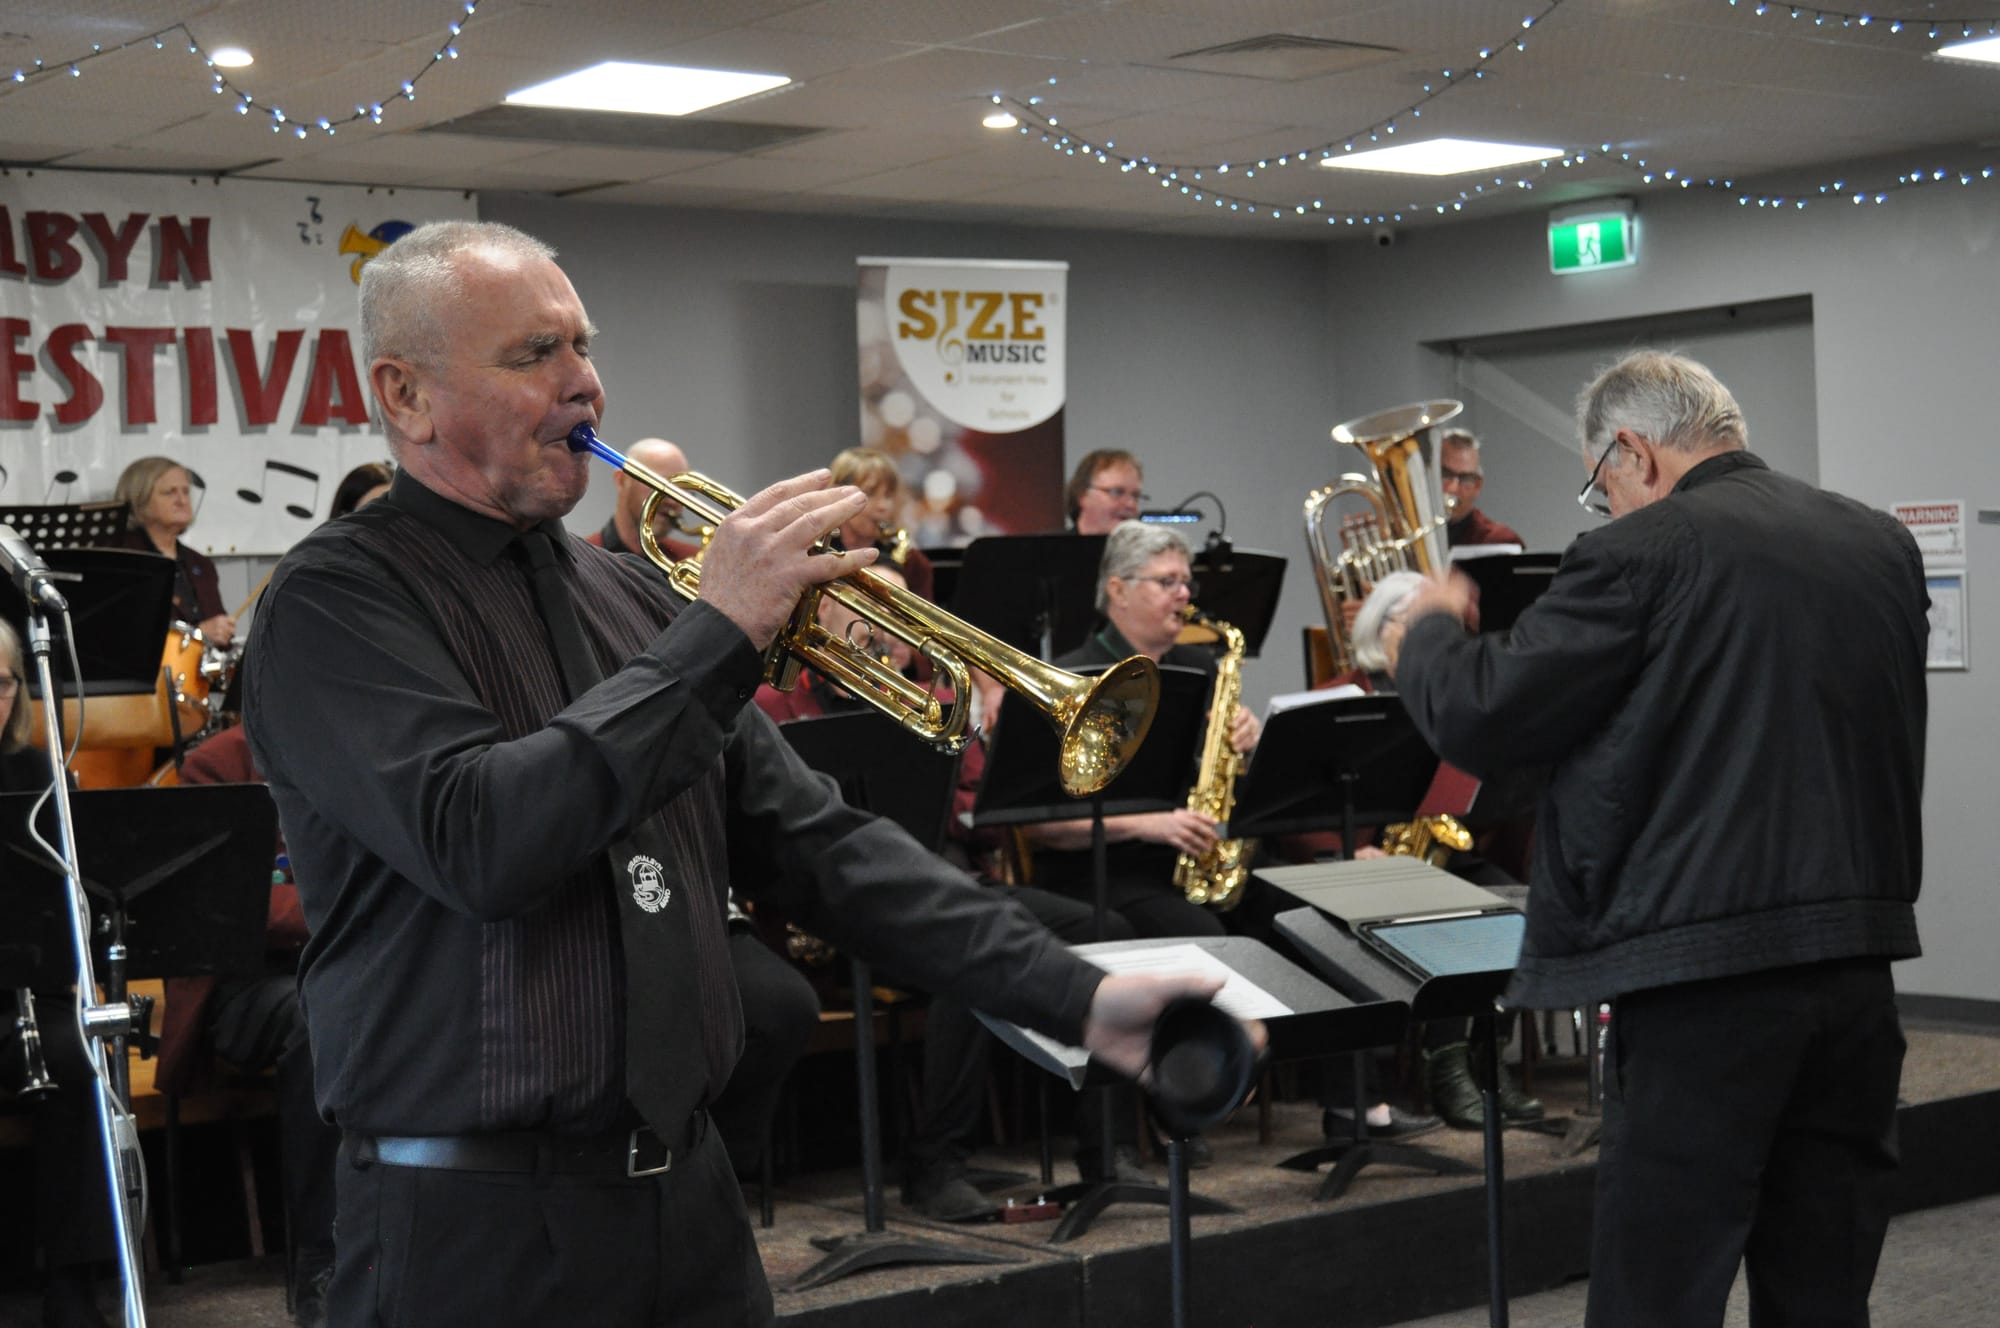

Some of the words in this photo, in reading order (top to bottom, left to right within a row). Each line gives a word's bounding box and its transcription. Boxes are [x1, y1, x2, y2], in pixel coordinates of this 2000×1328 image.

[898, 288, 1044, 341] SIZE
[966, 344, 1046, 364] MUSIC
[0, 317, 382, 430] ESTIVA
[1897, 509, 1959, 523] WARNING
